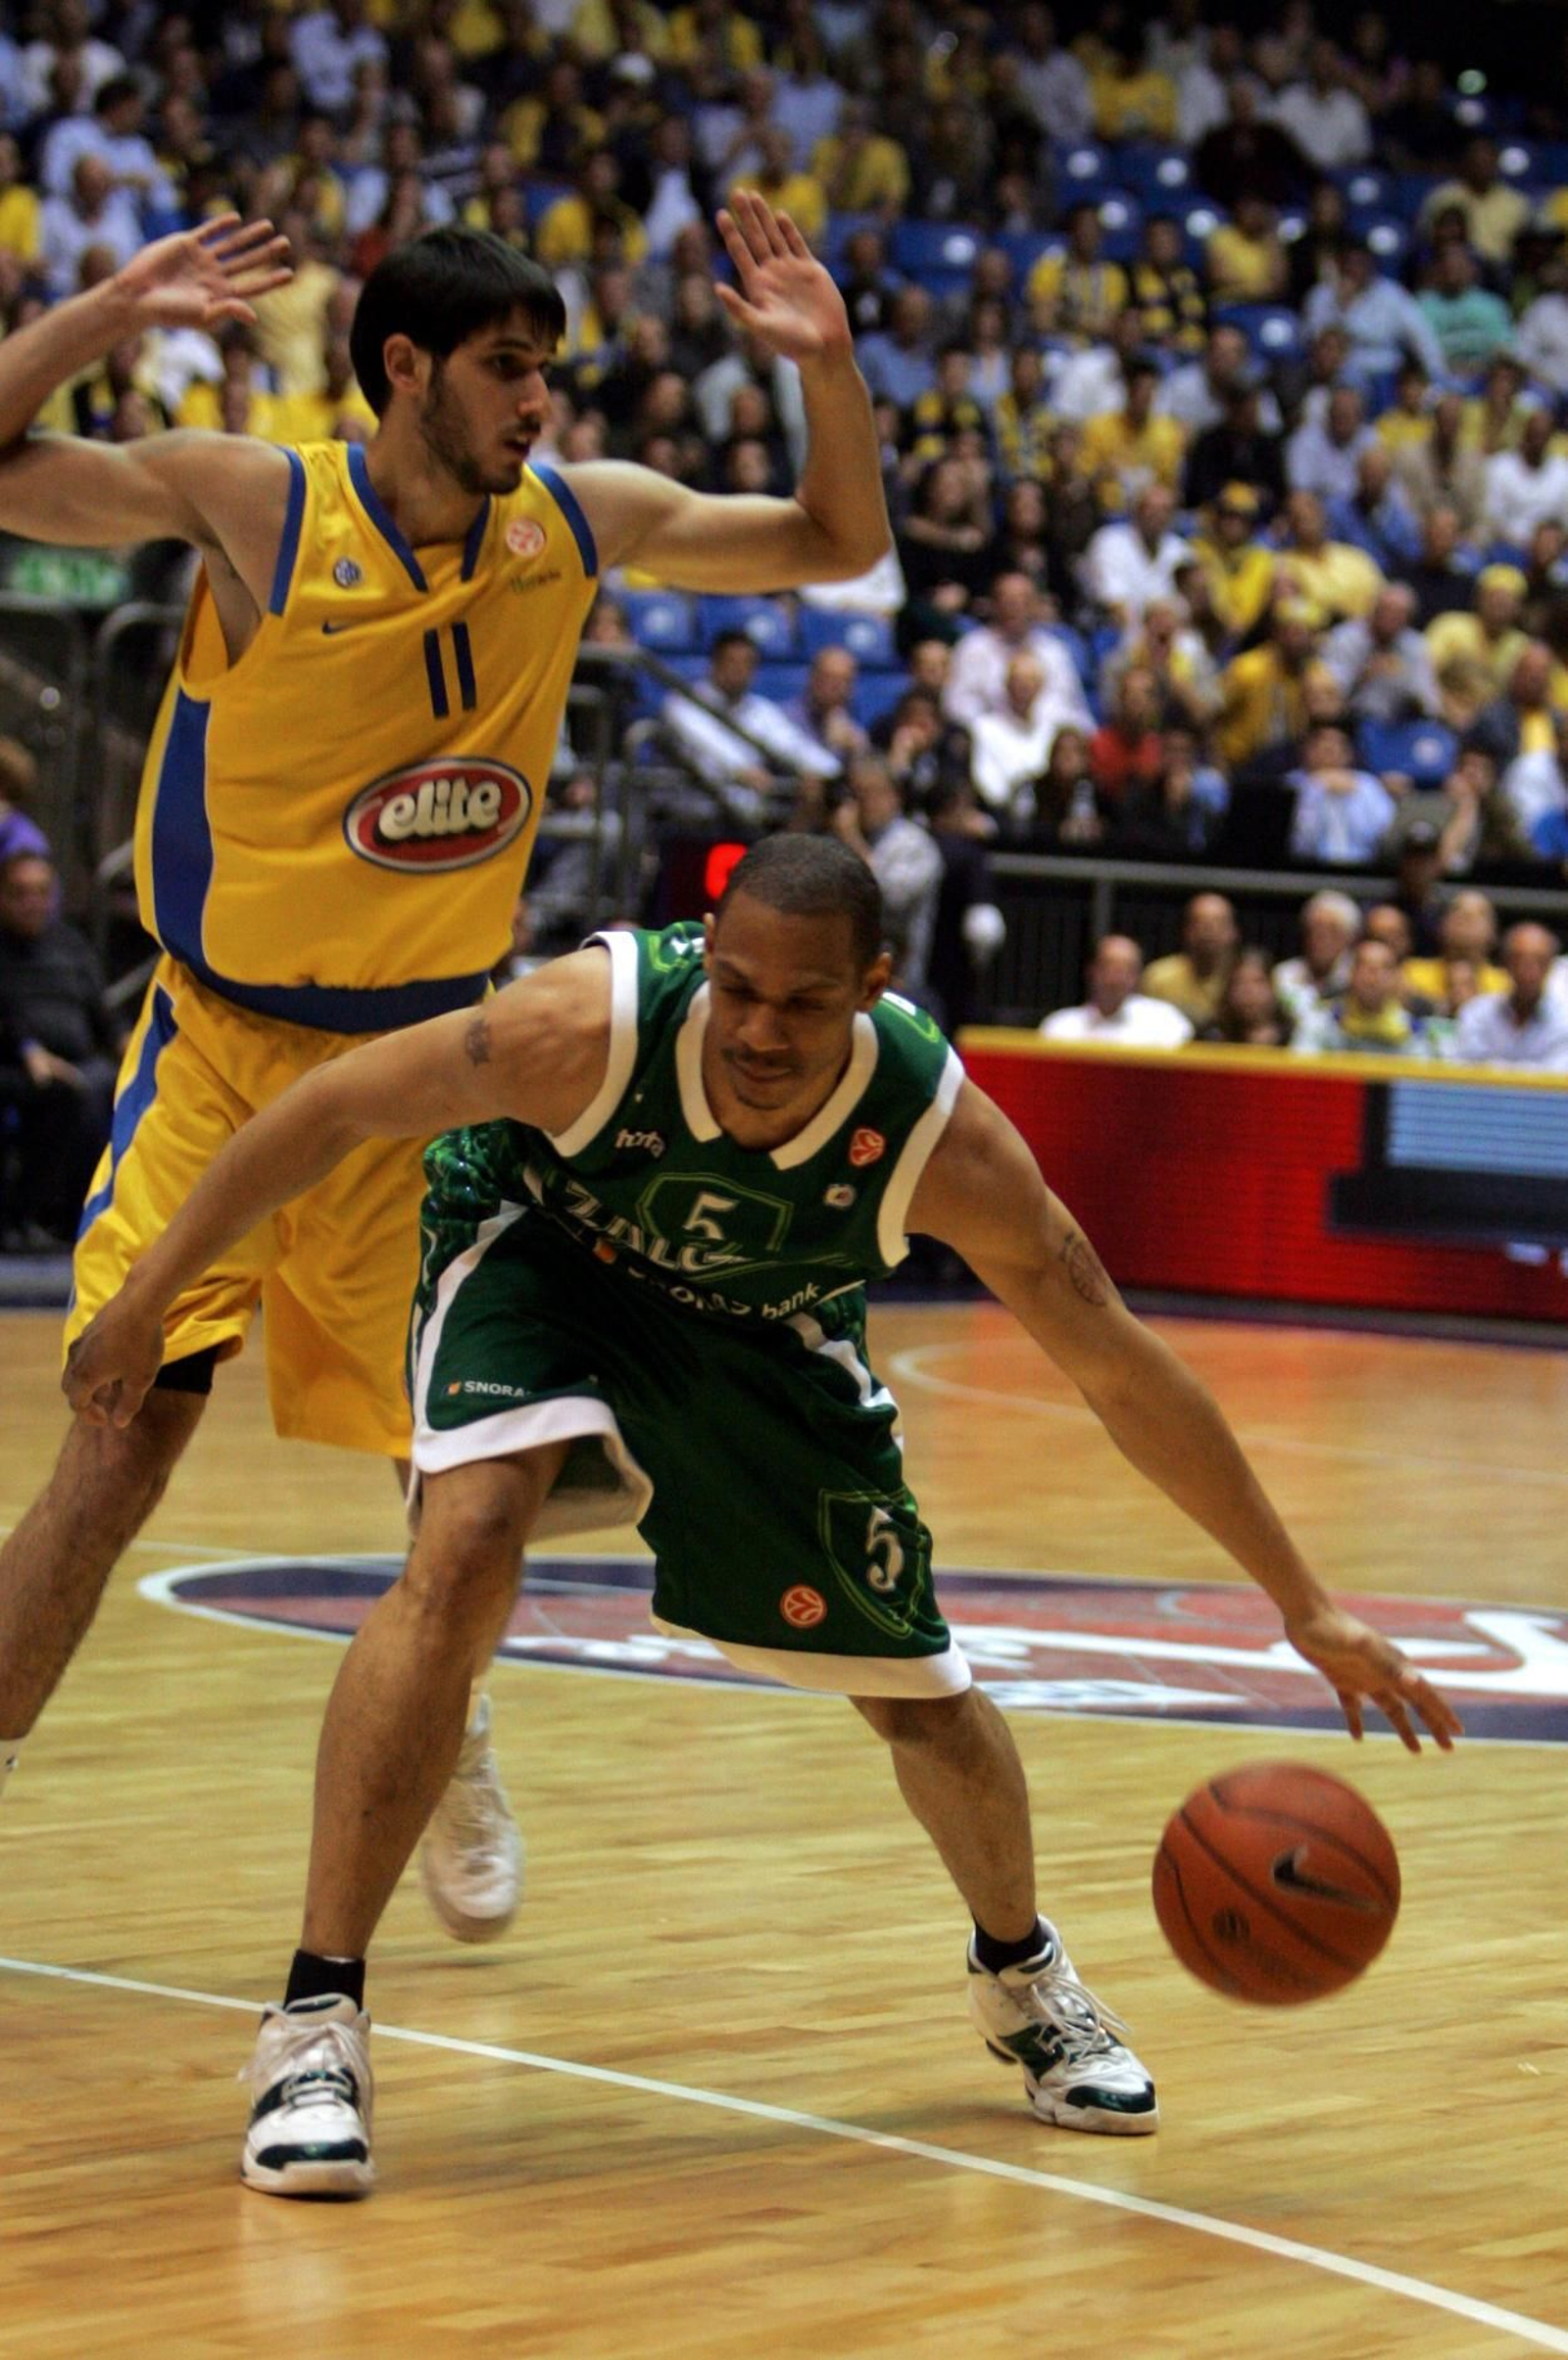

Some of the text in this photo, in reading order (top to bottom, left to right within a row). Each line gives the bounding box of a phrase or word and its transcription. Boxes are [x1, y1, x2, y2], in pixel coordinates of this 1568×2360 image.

[423, 621, 477, 718] 11
[378, 776, 503, 843] elite
[682, 1189, 742, 1242] 5
[761, 1281, 822, 1321] bank
[864, 1503, 906, 1594] 5
